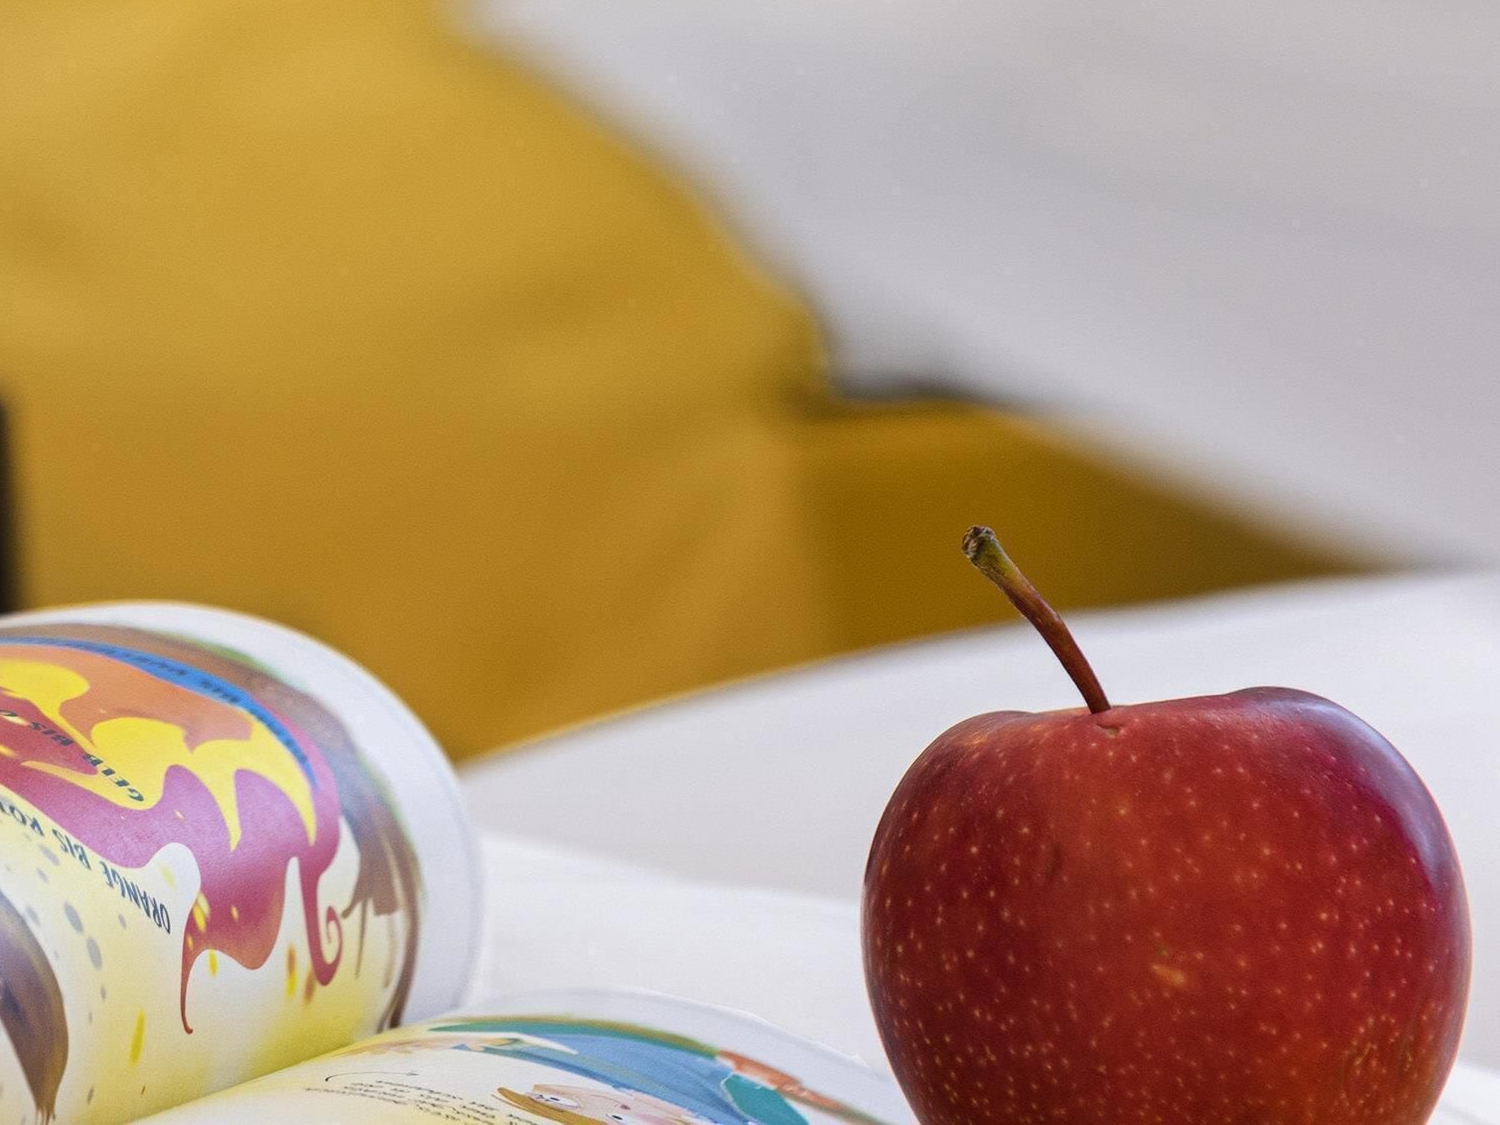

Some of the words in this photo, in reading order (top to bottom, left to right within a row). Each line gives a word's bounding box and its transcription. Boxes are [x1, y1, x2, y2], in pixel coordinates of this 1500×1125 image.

[28, 721, 75, 747] BIS
[82, 753, 145, 802] GELB
[52, 828, 92, 871] BIS
[100, 860, 171, 935] ORANGE
